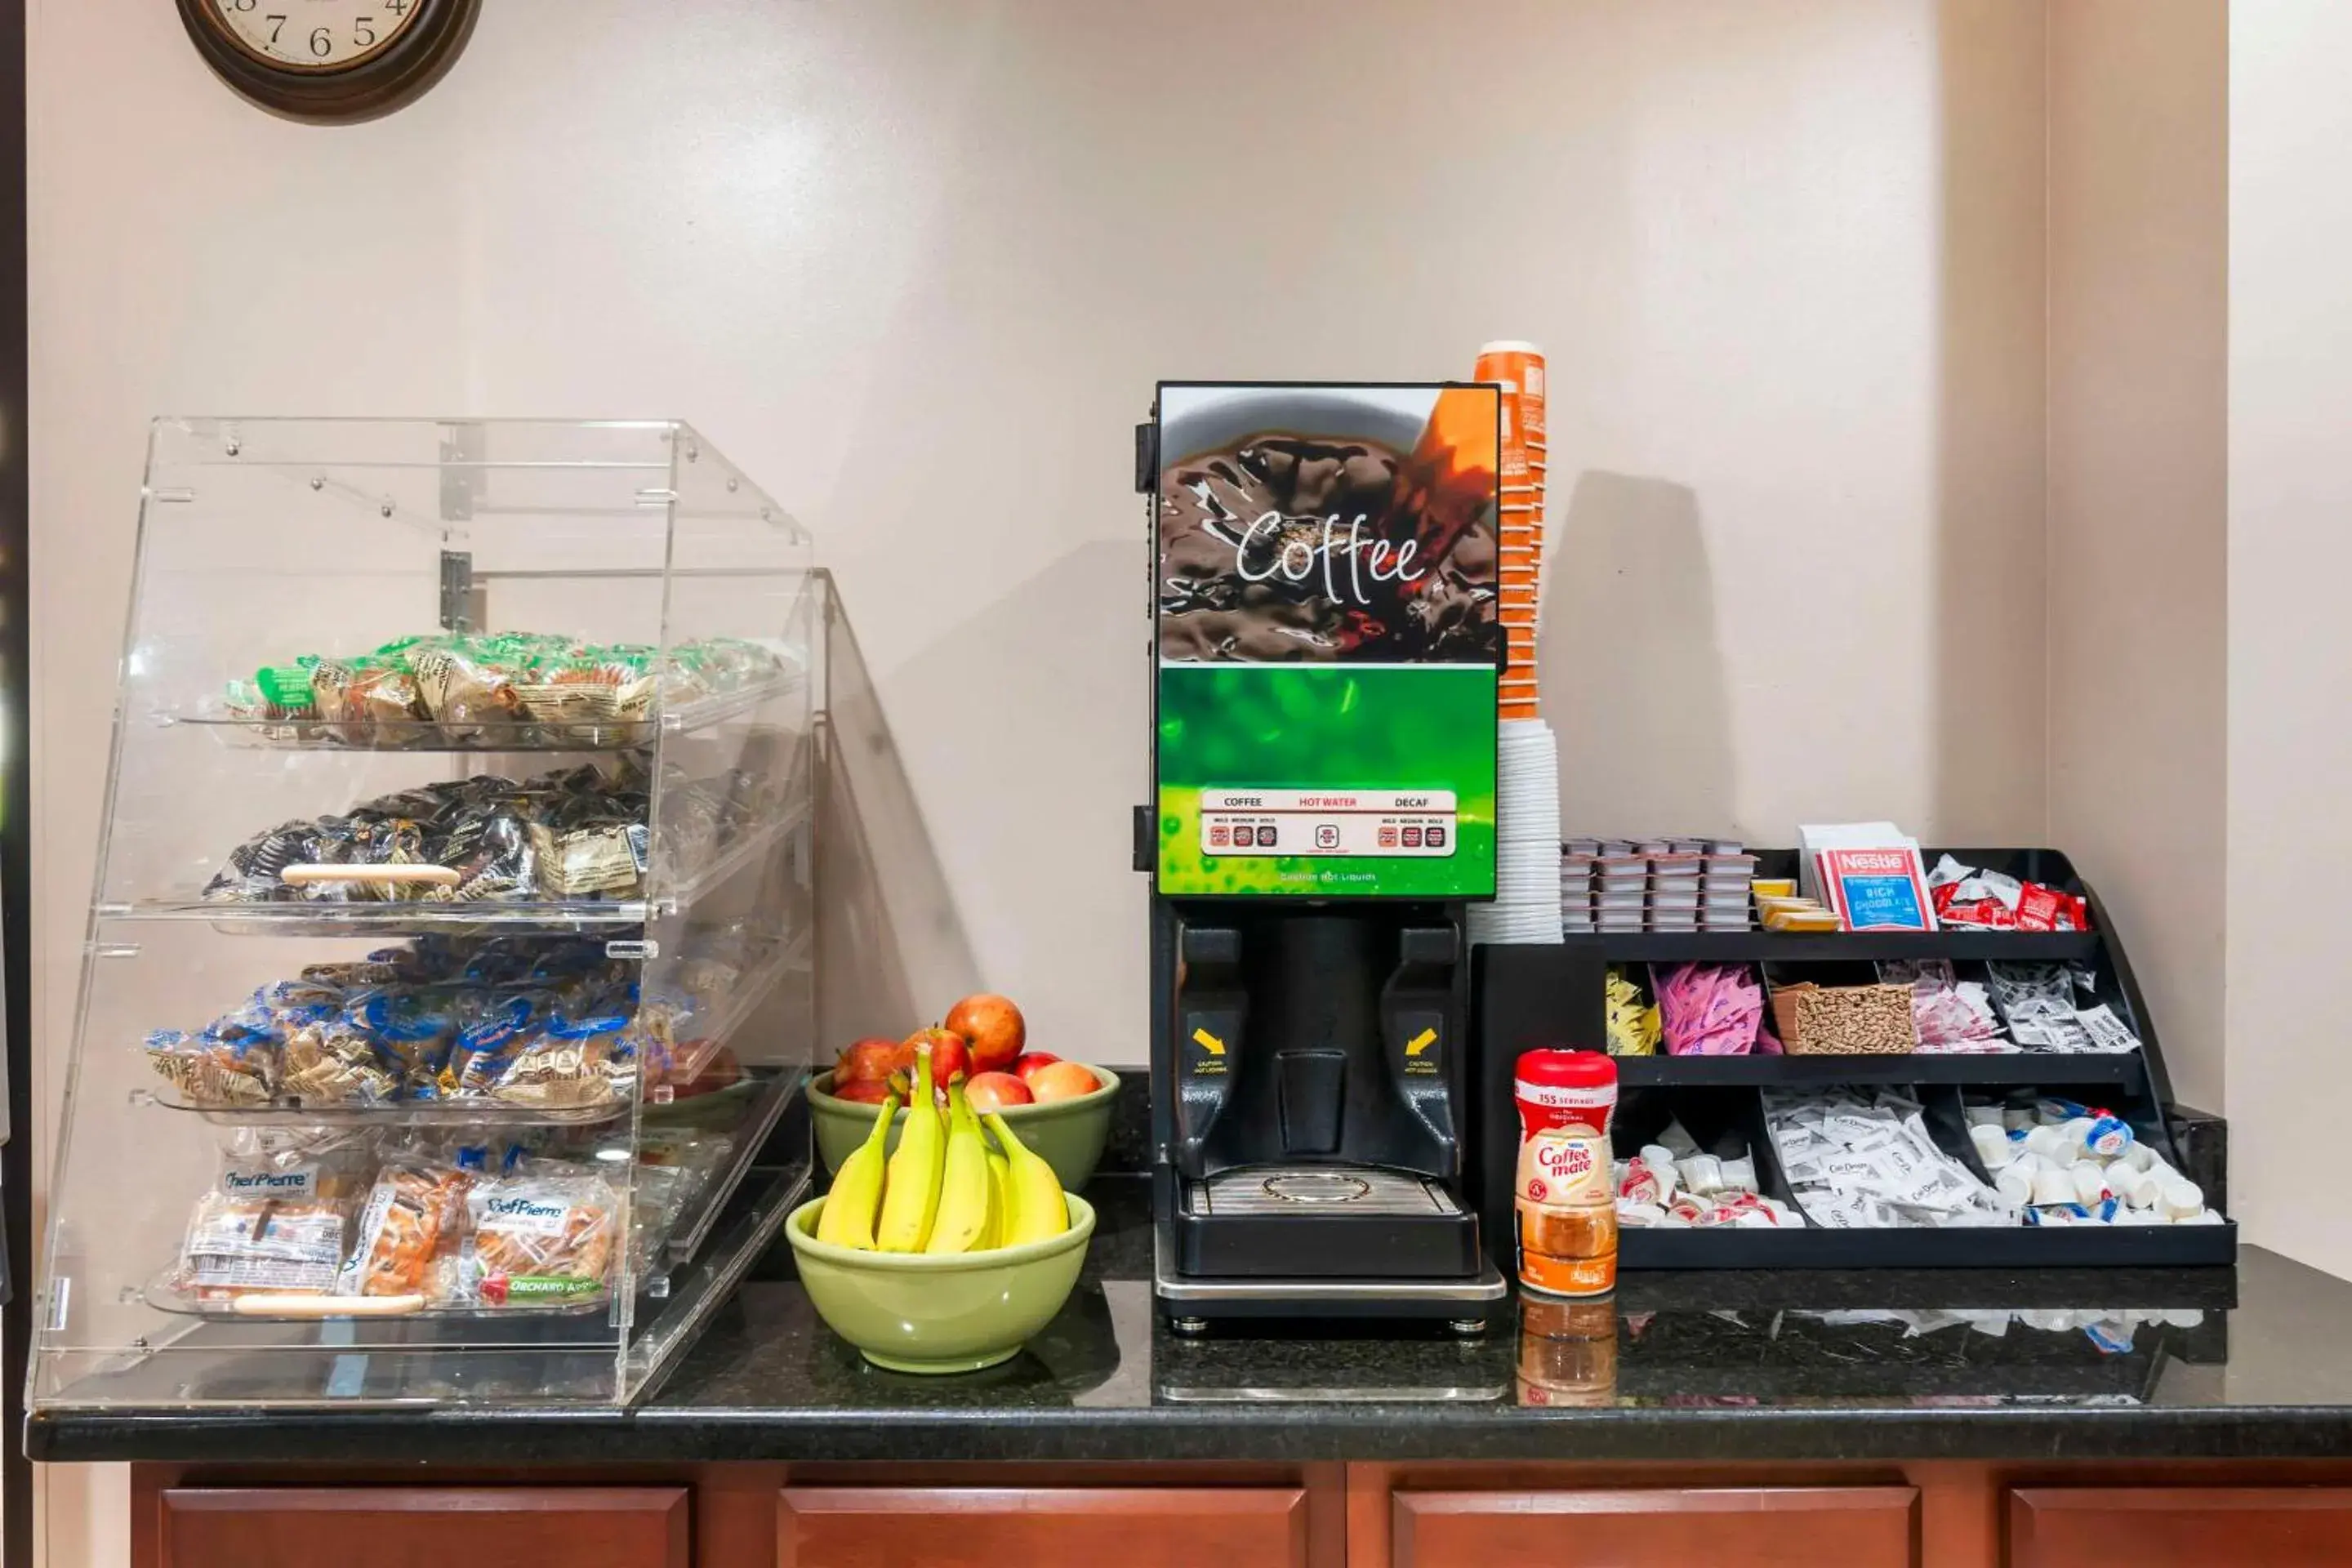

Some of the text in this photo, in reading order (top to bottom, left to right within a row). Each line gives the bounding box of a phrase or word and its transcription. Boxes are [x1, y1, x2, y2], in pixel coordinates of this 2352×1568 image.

[266, 15, 287, 43] 7
[354, 16, 376, 46] 5
[310, 27, 332, 57] 6
[1236, 510, 1425, 605] Coffee
[1224, 797, 1263, 807] COFFEE
[1299, 797, 1356, 807] HOT WATER
[1395, 797, 1429, 808] DECAF
[1539, 1094, 1557, 1104] 155
[1539, 1147, 1589, 1165] Coffee
[1552, 1160, 1592, 1177] mate
